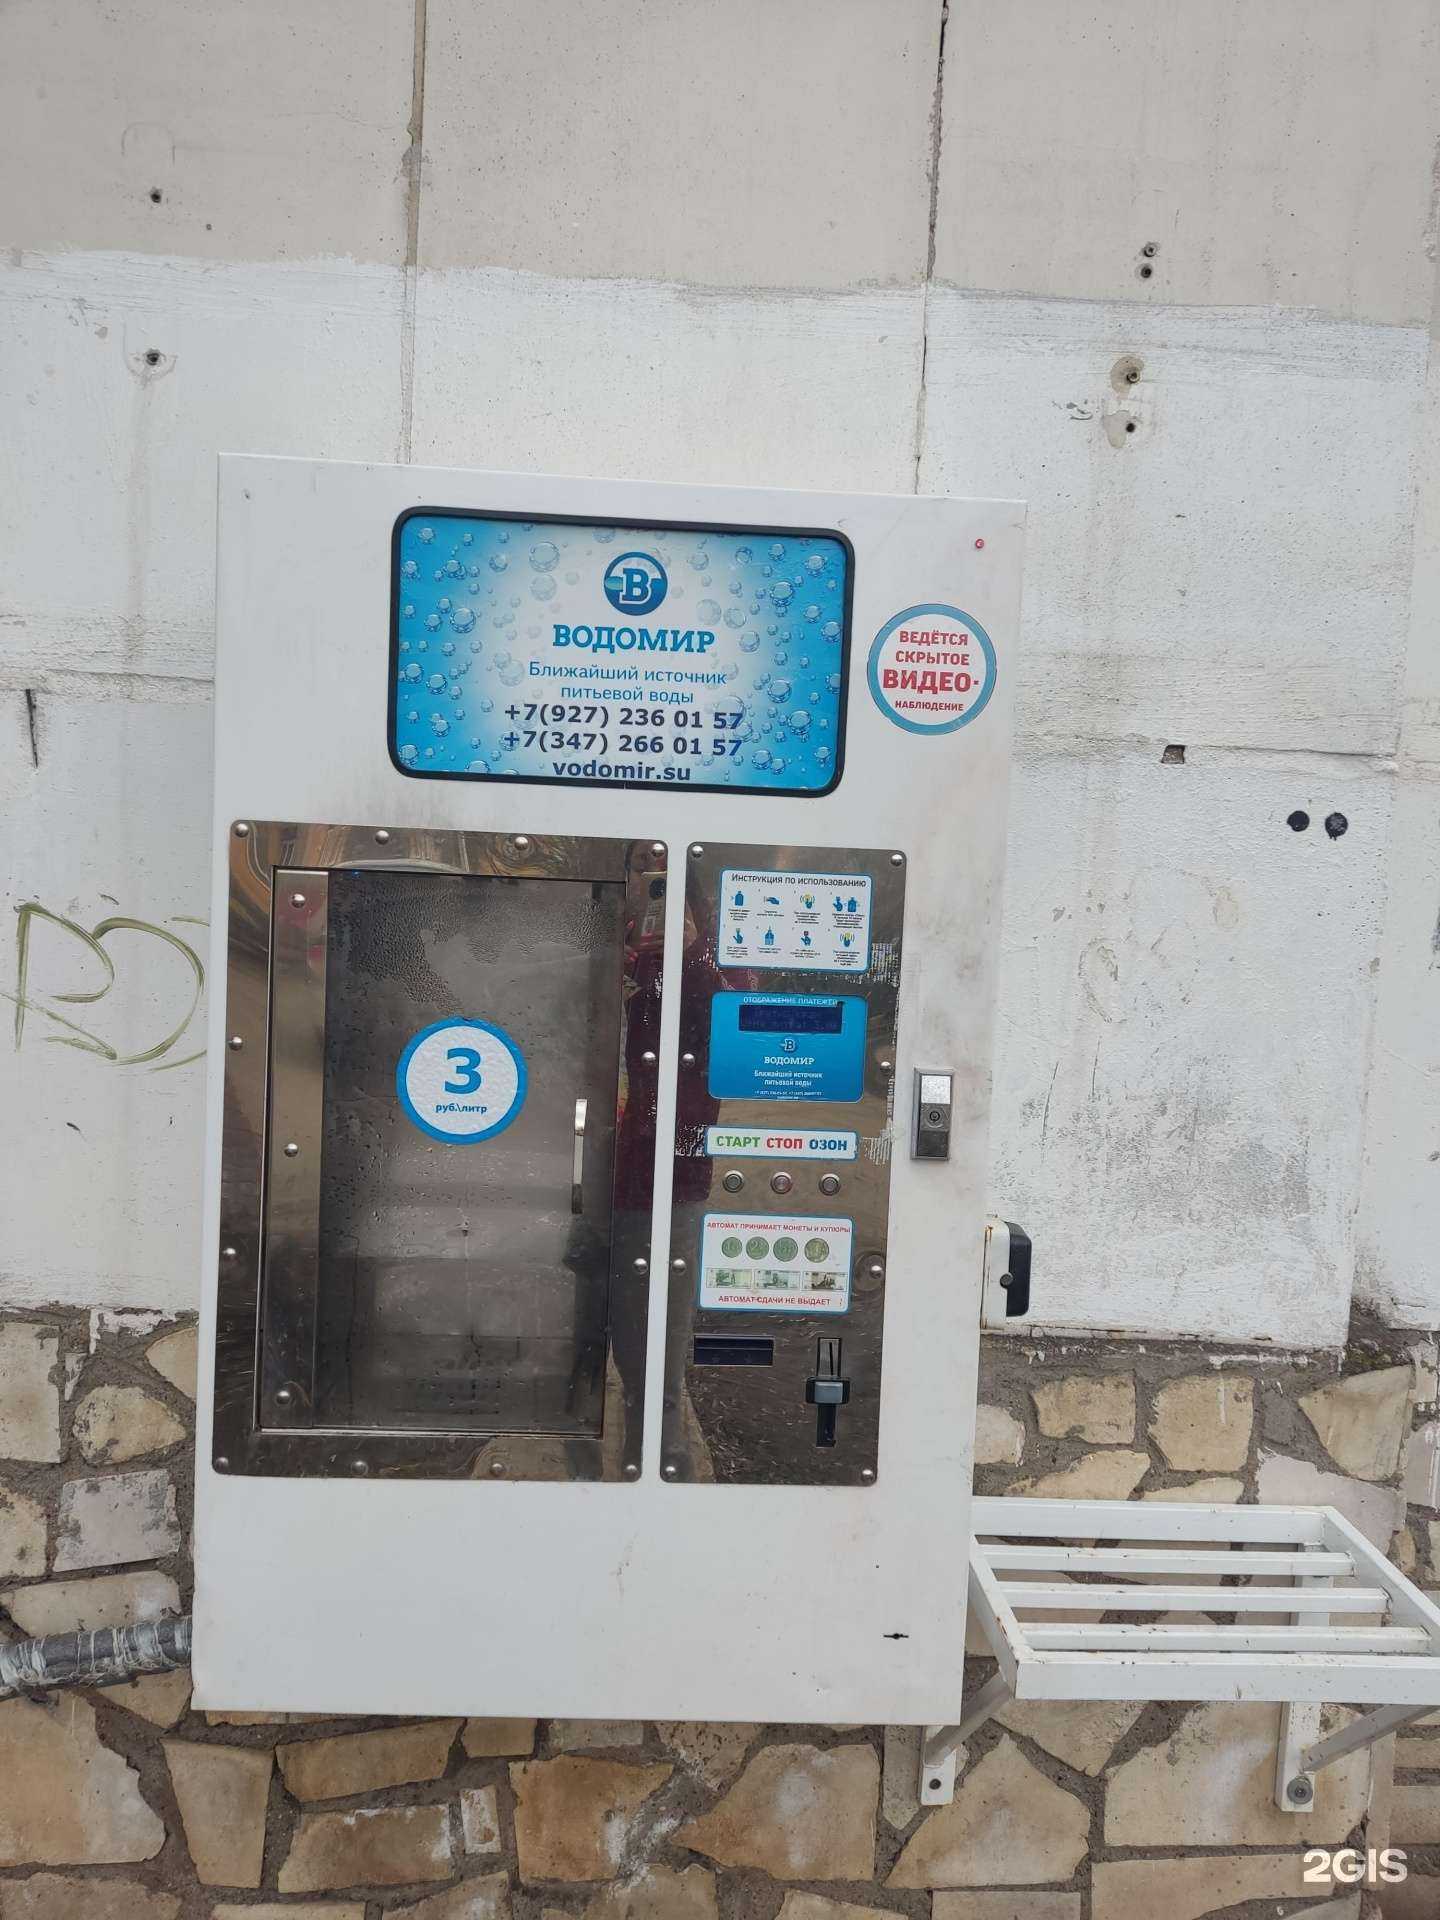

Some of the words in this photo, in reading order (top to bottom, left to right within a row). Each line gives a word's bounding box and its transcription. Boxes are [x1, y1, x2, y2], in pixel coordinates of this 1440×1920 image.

[552, 624, 716, 655] ВОДОМИР
[899, 630, 969, 646] ВЕДЁТСЯ
[895, 650, 970, 666] СКРЫТОЕ
[529, 661, 640, 683] Ближайший
[644, 669, 727, 685] источник
[883, 669, 980, 695] ВИДЕО-
[561, 684, 644, 703] питьевой
[648, 690, 694, 705] воды
[895, 700, 964, 711] НАБЛЮДЕНИЕ
[504, 704, 609, 729] +7(927)
[619, 708, 666, 728] 236
[674, 710, 703, 729] 01
[713, 711, 744, 730] 57
[503, 730, 609, 755] +7(347)
[618, 733, 665, 754] 266
[673, 735, 703, 755] 01
[712, 738, 743, 757] 57
[552, 760, 692, 781] vodomir.su
[785, 876, 796, 884] ПО
[797, 877, 867, 888] ИСПОЛЬЗОВАНИЮ
[764, 1056, 815, 1066] ВОДОМИР
[444, 1047, 482, 1094] 3
[754, 1069, 793, 1078] Ближайший
[793, 1071, 823, 1079] источник
[716, 1135, 761, 1148] СТАРТ
[766, 1137, 803, 1150] СТОП
[809, 1139, 848, 1151] ОЗОН
[740, 1223, 783, 1231] ПРИНИМАЕТ
[783, 1224, 813, 1232] МОНЕТЫ
[718, 1295, 755, 1303] АВТОМАТ
[797, 1298, 830, 1306] ВЫДАЕТ
